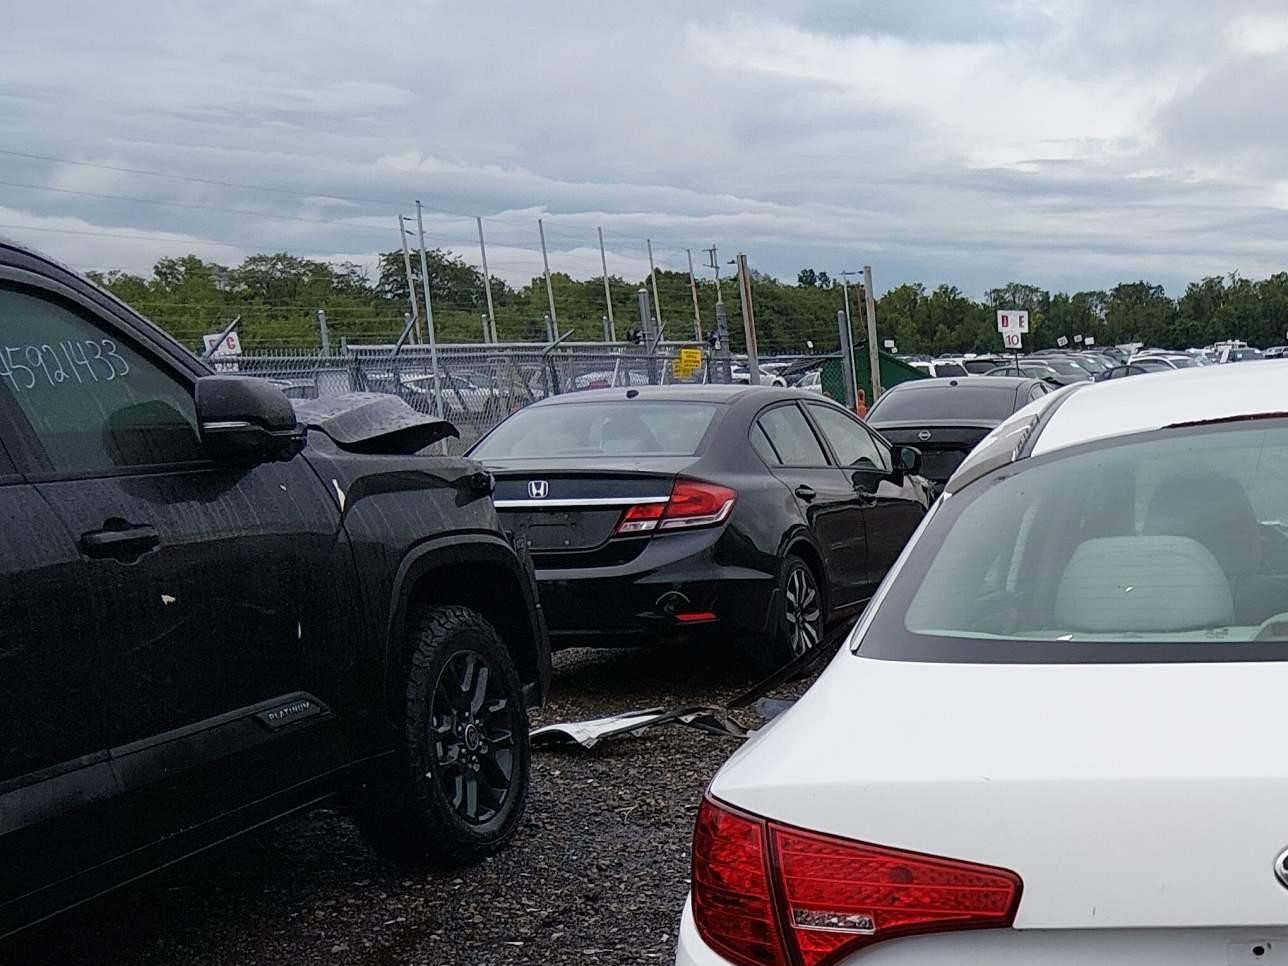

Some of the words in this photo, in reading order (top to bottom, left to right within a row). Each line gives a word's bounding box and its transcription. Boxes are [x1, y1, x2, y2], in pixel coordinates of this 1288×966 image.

[1001, 314, 1009, 328] D
[1018, 315, 1025, 329] E
[1006, 334, 1020, 346] 10
[268, 701, 310, 720] PLATINUM
